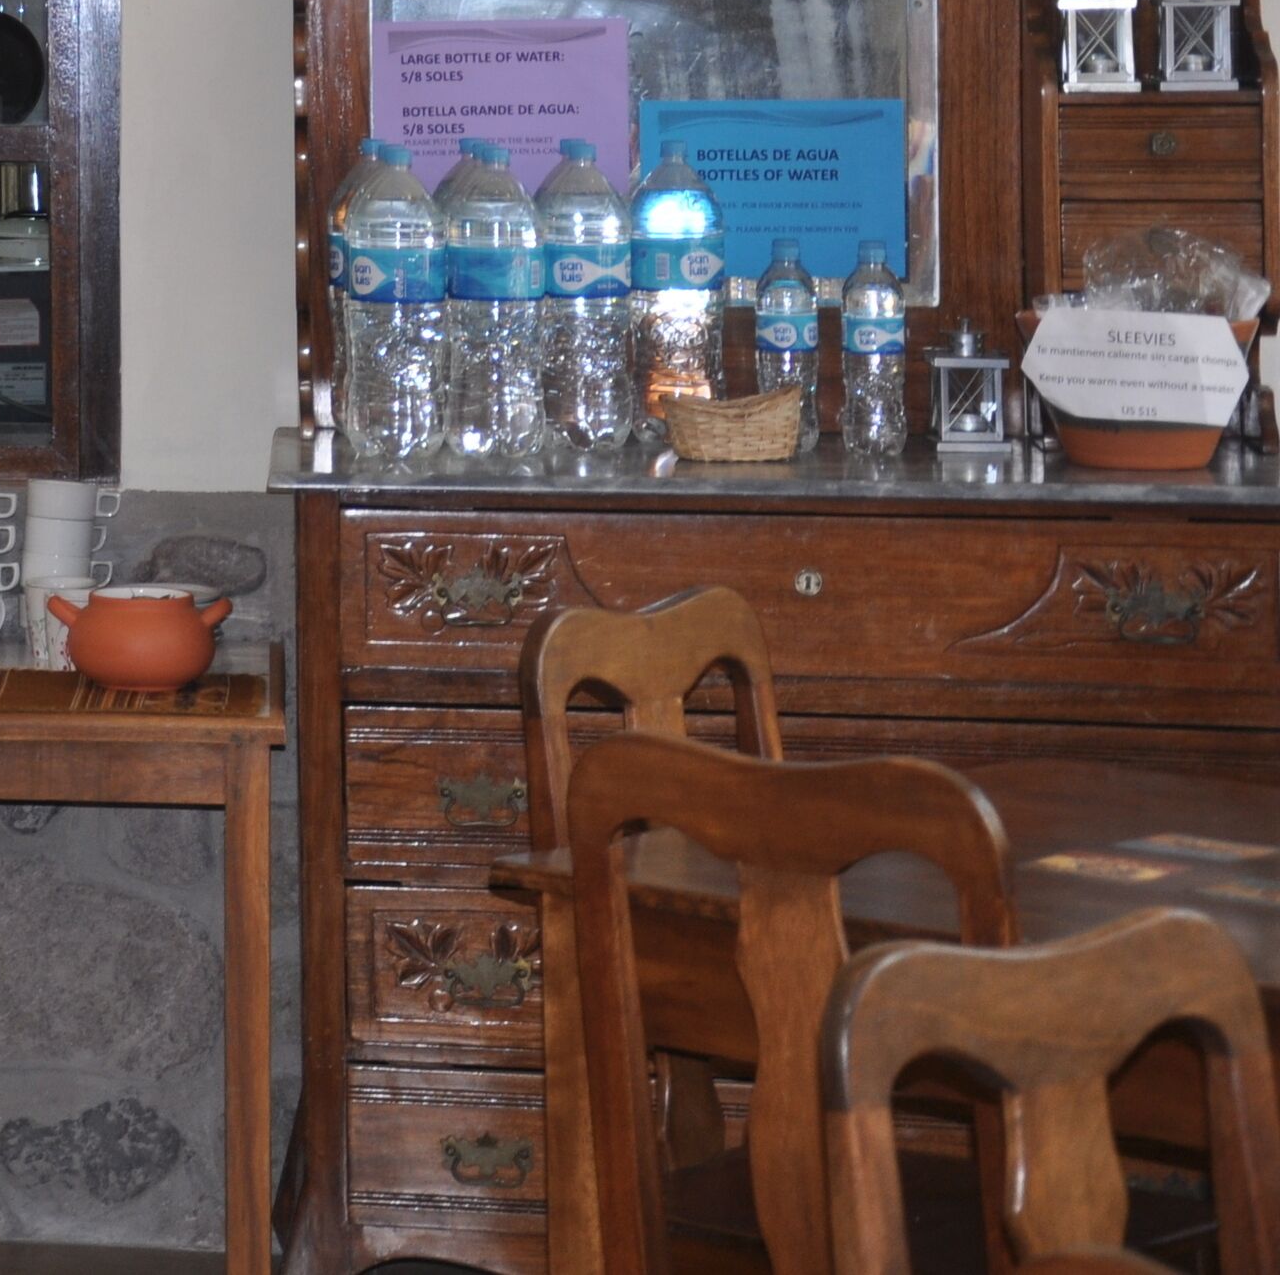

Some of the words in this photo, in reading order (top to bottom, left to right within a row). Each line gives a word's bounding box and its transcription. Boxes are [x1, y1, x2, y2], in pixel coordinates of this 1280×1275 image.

[400, 54, 441, 65] LARGE
[444, 52, 491, 64] BOTTLE
[495, 51, 513, 63] OF
[515, 50, 565, 63] WATER:
[400, 71, 423, 84] S/8
[425, 70, 464, 83] SOLES
[402, 105, 457, 118] BOTELLA
[460, 104, 514, 117] GRANDE
[517, 104, 535, 116] DE
[538, 103, 580, 116] AGUA:
[402, 124, 424, 137] S/8
[427, 123, 465, 135] SOLES
[403, 138, 430, 147] PLEASE
[432, 138, 448, 146] PUT
[508, 137, 523, 145] THE
[525, 136, 553, 145] BASKET
[696, 149, 769, 162] BOTELLAS
[773, 149, 792, 162] DE
[796, 148, 839, 162] AGUA
[697, 168, 761, 181] BOTTLES
[764, 168, 783, 181] OF
[788, 168, 839, 181] WATER
[559, 261, 584, 271] san
[687, 255, 710, 265] san
[561, 270, 583, 282] luis
[689, 265, 709, 276] luis
[1107, 330, 1176, 346] SLEEVIES
[1049, 347, 1105, 358] mantienen
[1107, 349, 1148, 361] caliente
[1150, 352, 1166, 362] sin
[1168, 355, 1200, 366] cargar
[1039, 372, 1065, 386] Keep
[1066, 376, 1086, 387] you
[1087, 378, 1118, 387] warm
[1120, 380, 1146, 388] even
[1147, 380, 1189, 391] without
[1121, 406, 1137, 416] US
